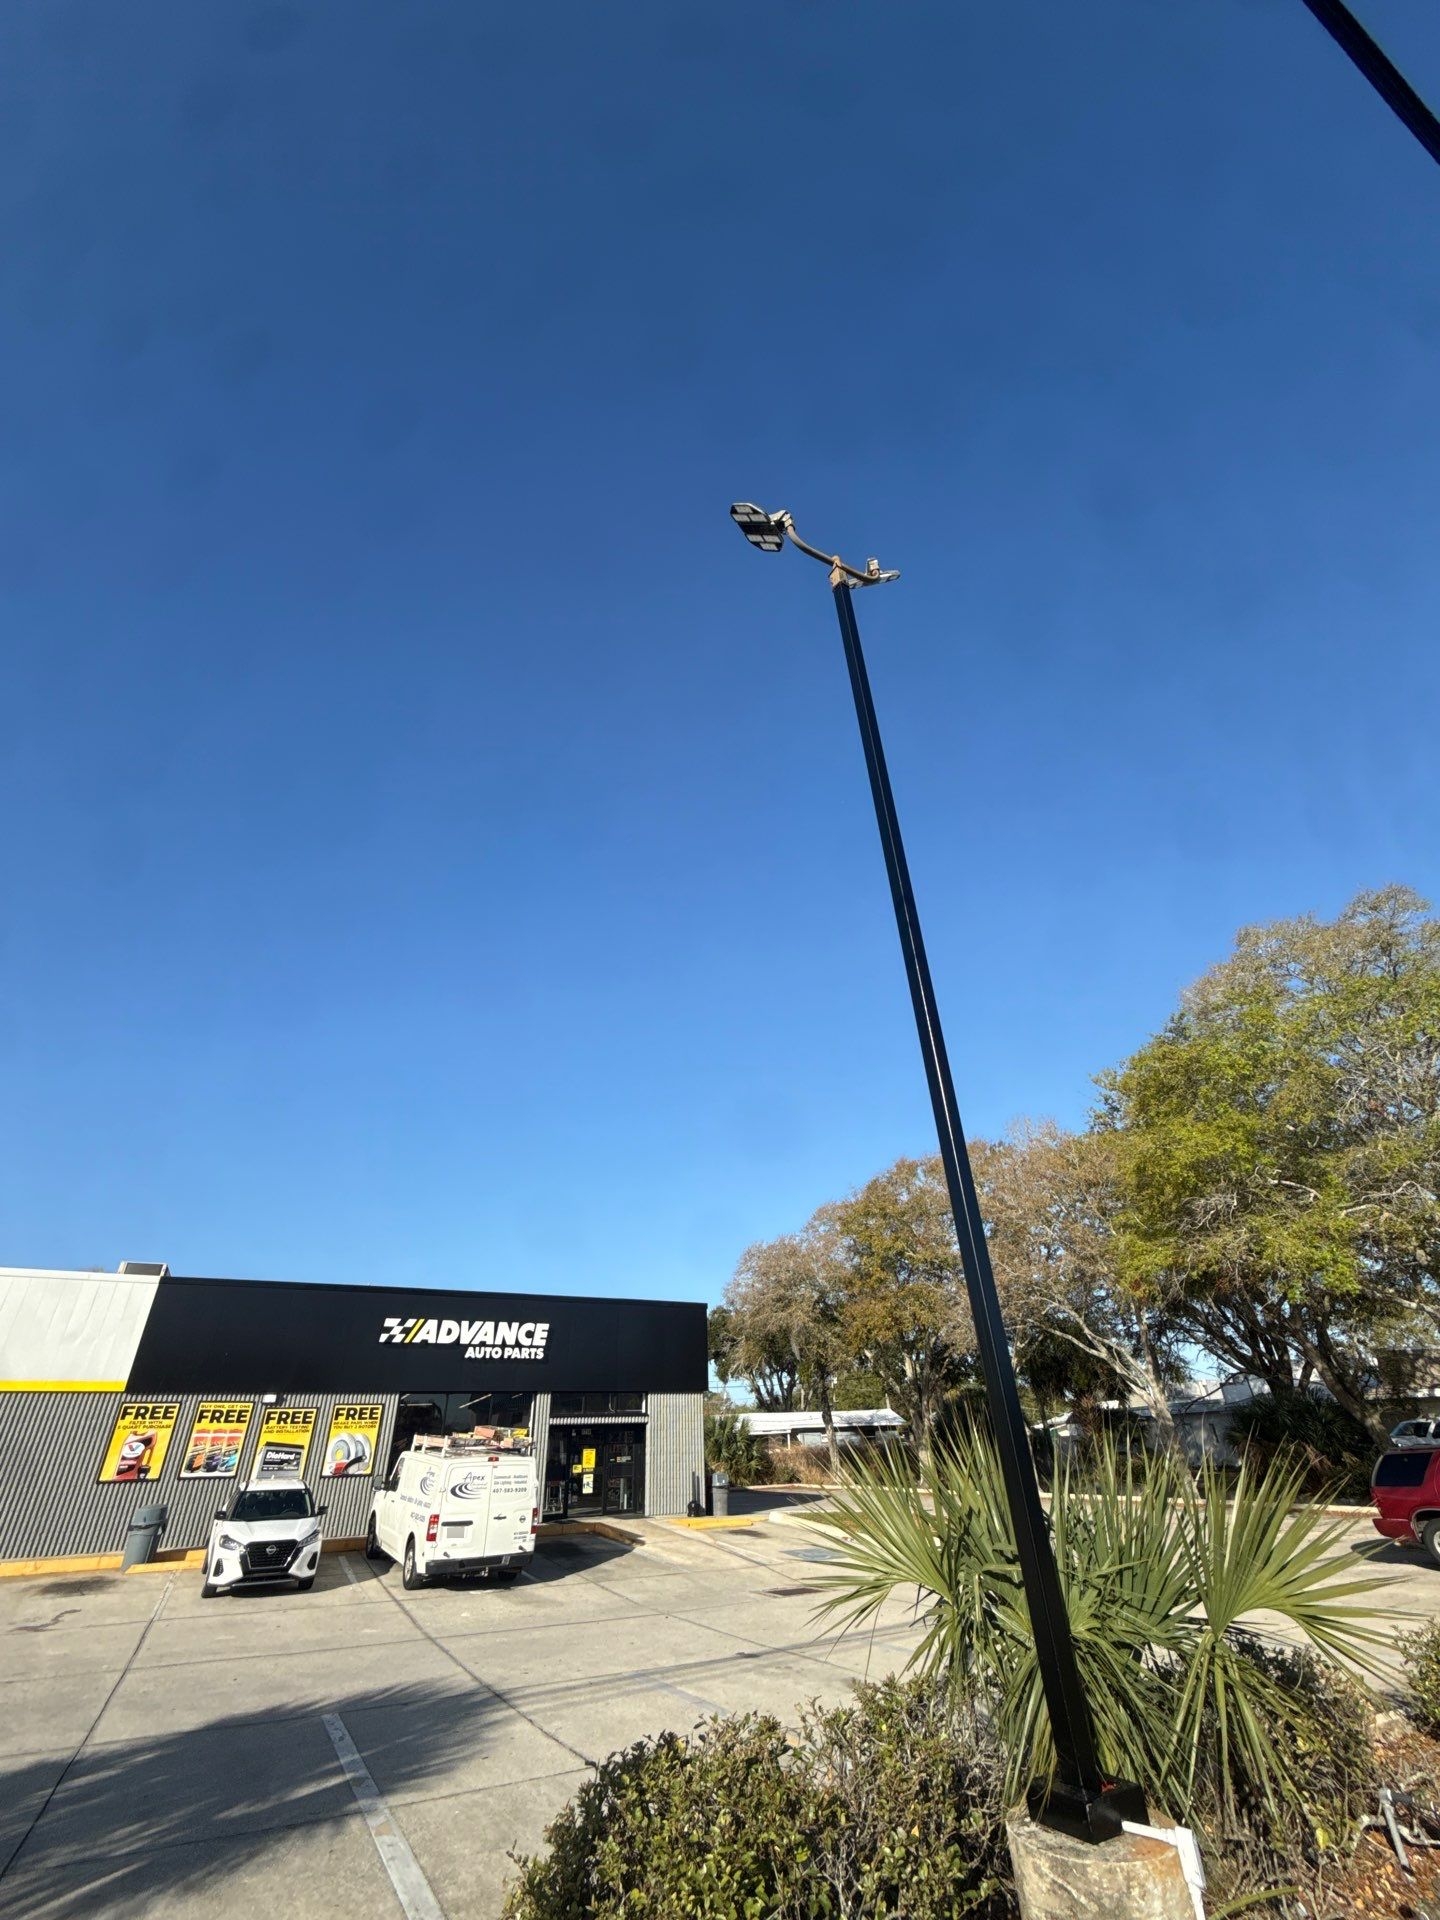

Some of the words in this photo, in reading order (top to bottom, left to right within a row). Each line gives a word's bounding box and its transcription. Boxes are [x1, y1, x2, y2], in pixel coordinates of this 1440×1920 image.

[412, 1318, 550, 1346] ADVANCE
[464, 1346, 503, 1359] AUTO
[503, 1347, 544, 1360] PARTS
[120, 1405, 177, 1420] FREE
[197, 1409, 251, 1424] FREE
[265, 1410, 314, 1425] FREE
[334, 1406, 380, 1420] FREE
[266, 1451, 295, 1460] DieHard
[462, 1471, 486, 1485] Apex
